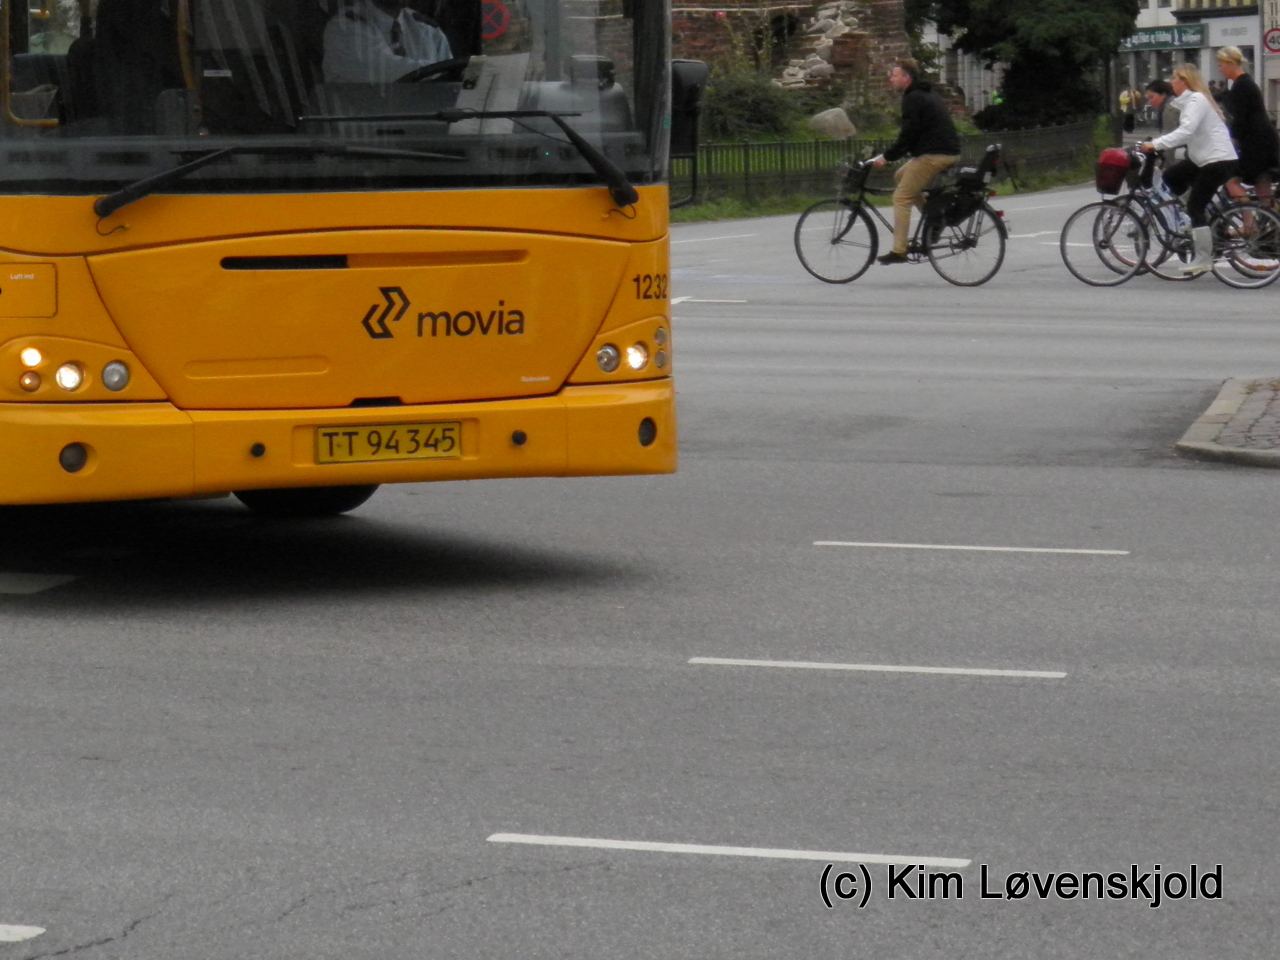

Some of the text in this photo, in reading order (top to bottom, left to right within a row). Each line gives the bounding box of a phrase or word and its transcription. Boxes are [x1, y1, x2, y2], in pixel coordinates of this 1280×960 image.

[632, 273, 669, 300] 1232
[417, 299, 526, 338] movia
[322, 431, 360, 457] TT
